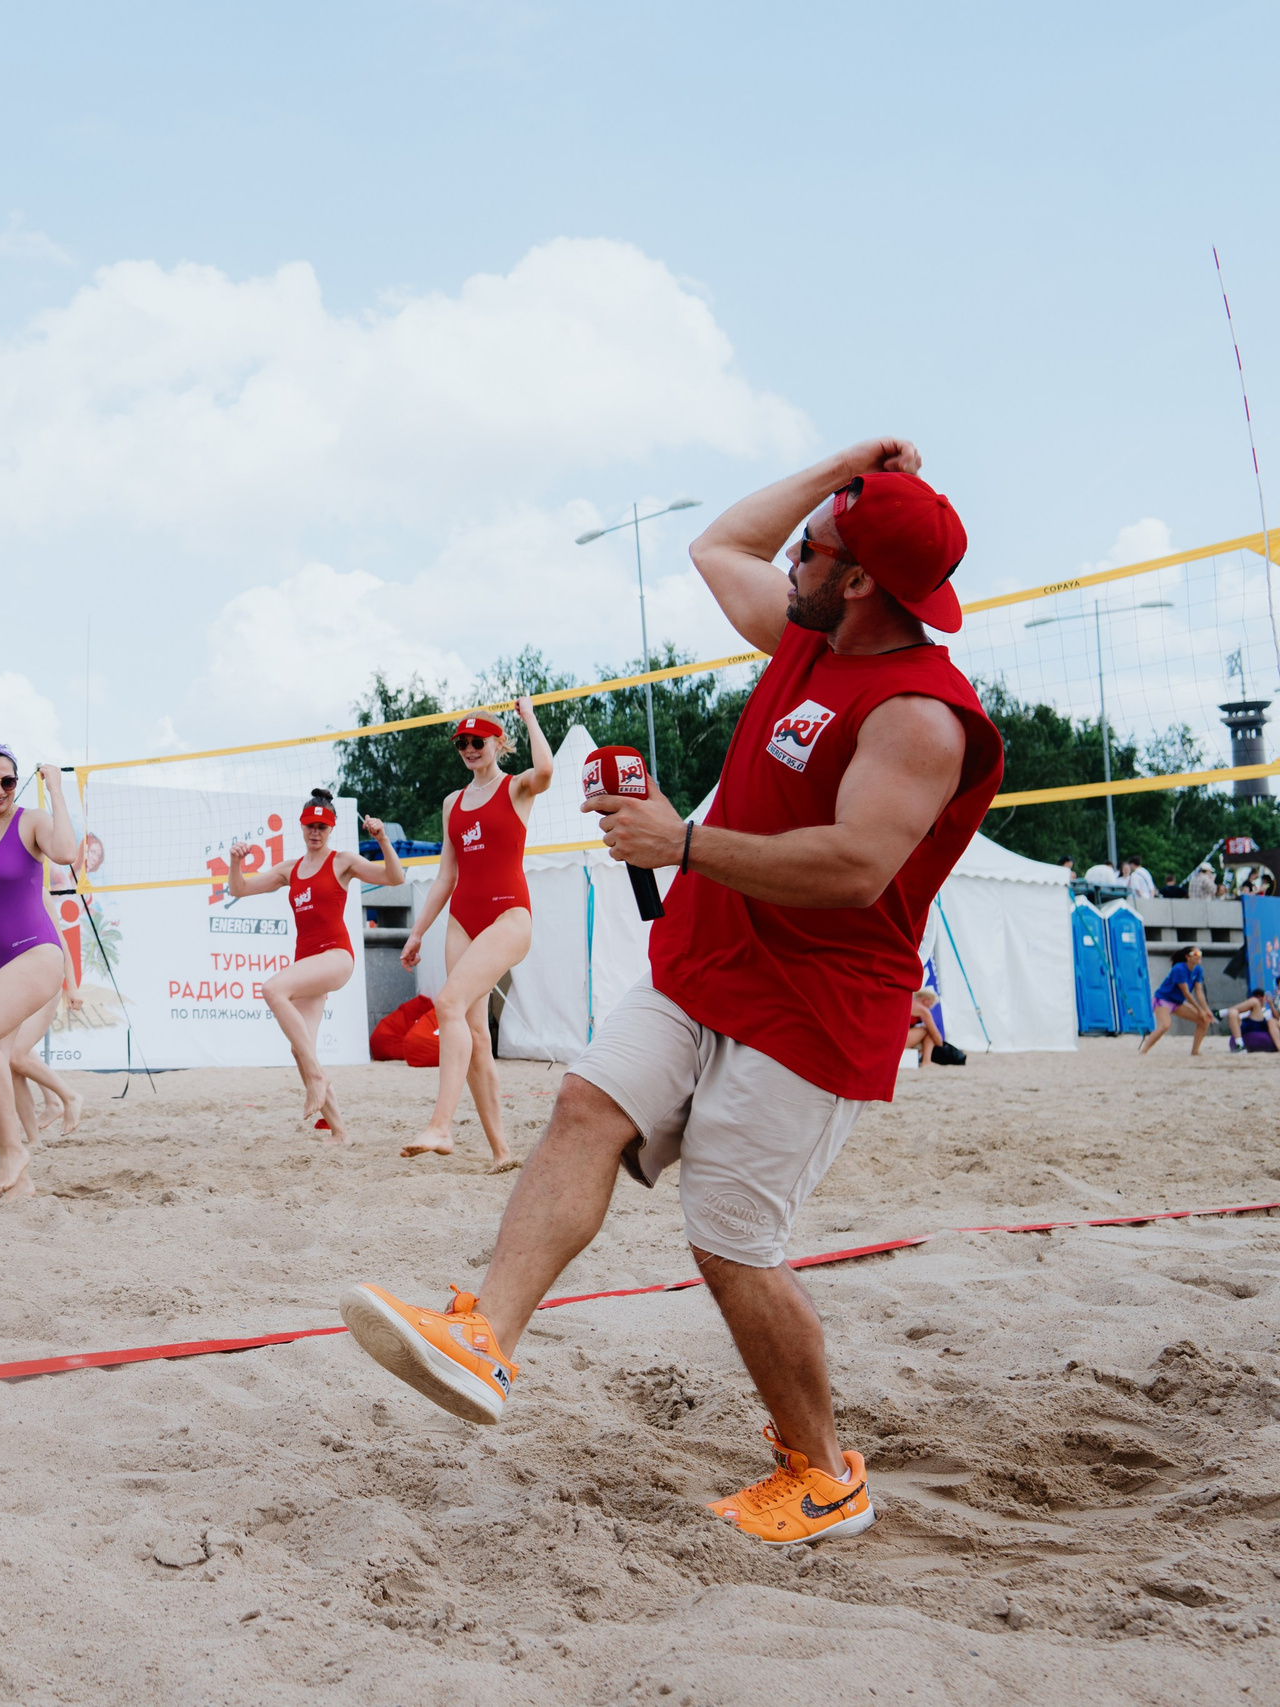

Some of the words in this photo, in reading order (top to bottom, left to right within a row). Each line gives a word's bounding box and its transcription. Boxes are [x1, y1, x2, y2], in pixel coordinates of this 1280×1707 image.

[1043, 580, 1080, 594] COPAYA
[728, 653, 755, 664] COPAYA
[767, 743, 787, 761] ENERGY
[786, 757, 804, 771] 95.0
[205, 827, 265, 855] РАДИО
[210, 918, 259, 935] ENERGY
[259, 920, 287, 934] 95.0
[211, 953, 291, 972] ТУРНИР
[169, 980, 244, 1001] РАДИО
[171, 1008, 189, 1019] ПО
[192, 1008, 262, 1020] ПЛЯЖНОМУ
[699, 1205, 759, 1239] STREAK
